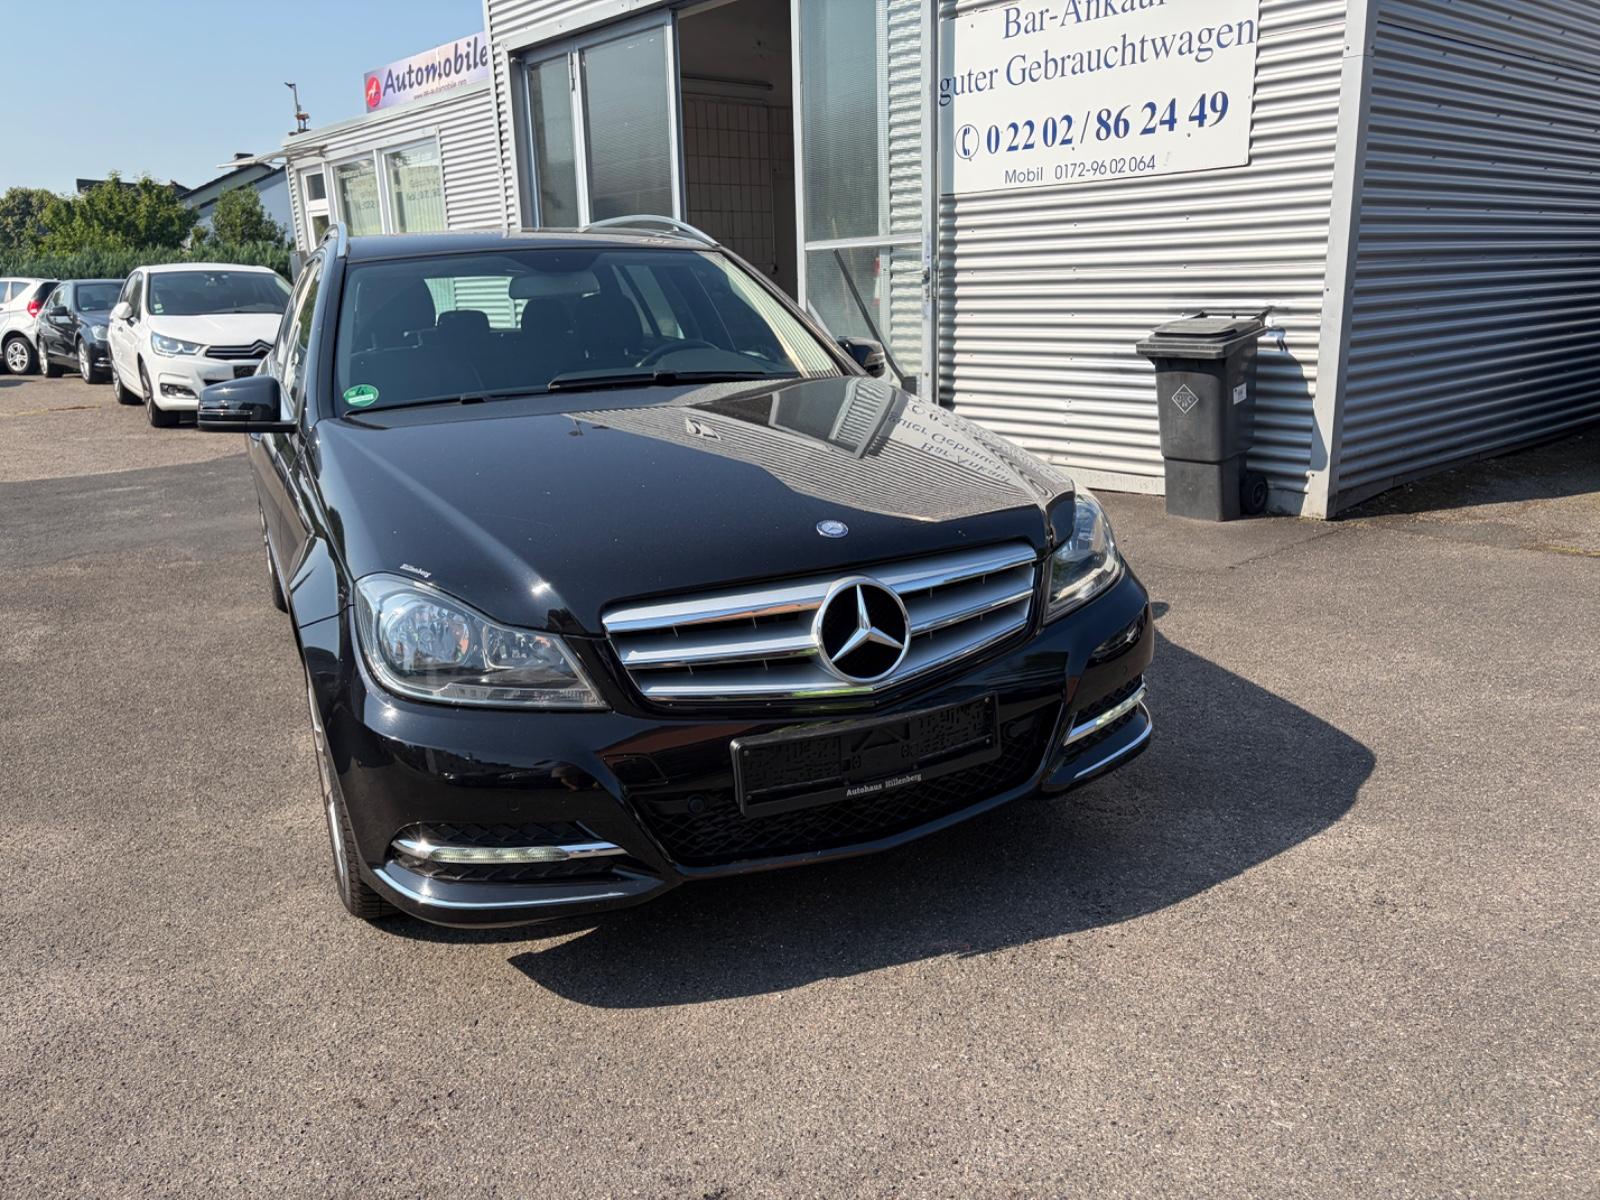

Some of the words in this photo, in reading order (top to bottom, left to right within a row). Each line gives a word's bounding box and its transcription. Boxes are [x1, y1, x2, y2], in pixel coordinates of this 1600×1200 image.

[938, 68, 998, 107] guter
[1005, 18, 1255, 87] Gebrauchtwagen
[1004, 166, 1043, 184] Mobil
[846, 783, 882, 797] Autohaus
